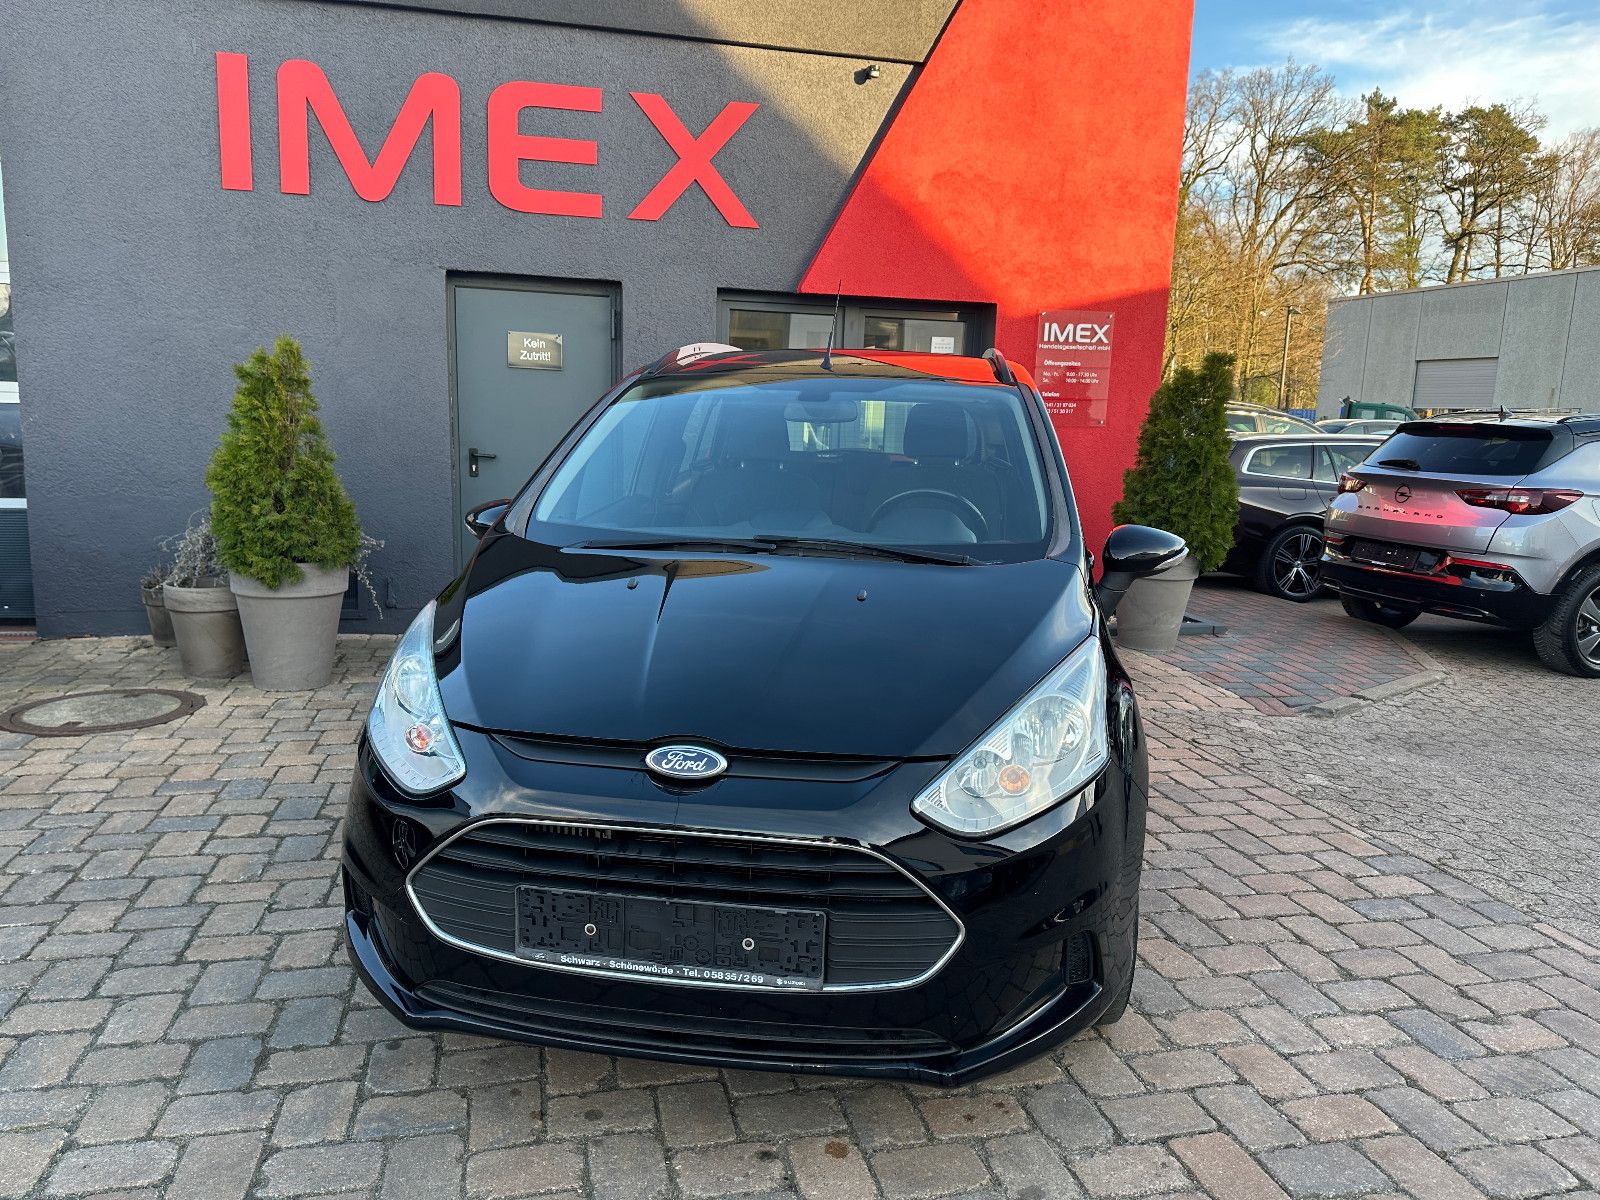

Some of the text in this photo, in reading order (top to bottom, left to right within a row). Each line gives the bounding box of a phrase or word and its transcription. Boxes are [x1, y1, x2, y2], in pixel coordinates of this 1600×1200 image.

[216, 51, 760, 229] IMEX
[523, 338, 546, 349] Kein
[1043, 322, 1110, 344] IMEX
[519, 350, 551, 362] Zutritt!
[1043, 359, 1081, 367] Öffnungszeiten
[661, 750, 708, 771] Ford
[560, 954, 601, 967] Schwarz
[608, 960, 674, 975] Schönewörde
[683, 967, 701, 978] Tel.
